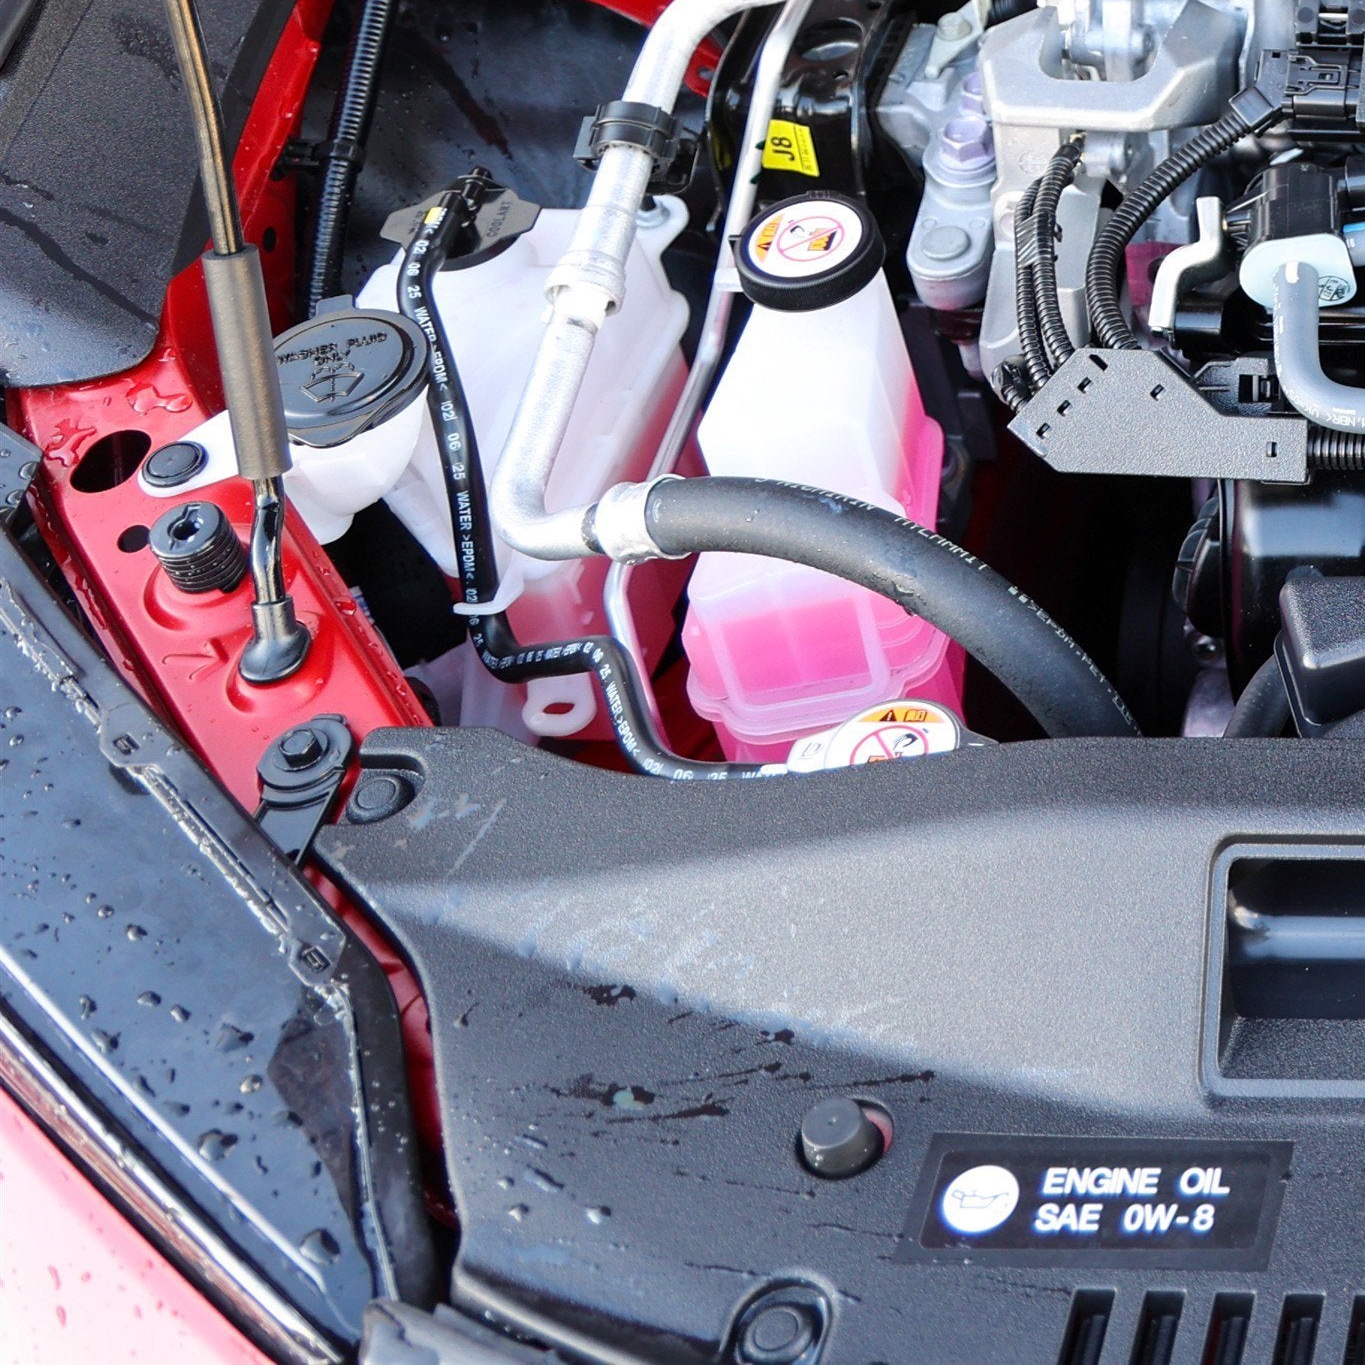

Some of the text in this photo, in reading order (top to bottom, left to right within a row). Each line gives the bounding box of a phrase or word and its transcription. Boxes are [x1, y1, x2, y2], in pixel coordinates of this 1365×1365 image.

[456, 490, 473, 531] WATER
[605, 681, 623, 719] WATER
[1042, 1167, 1231, 1195] ENGINE OIL
[1034, 1203, 1216, 1232] SAE 0W-8
